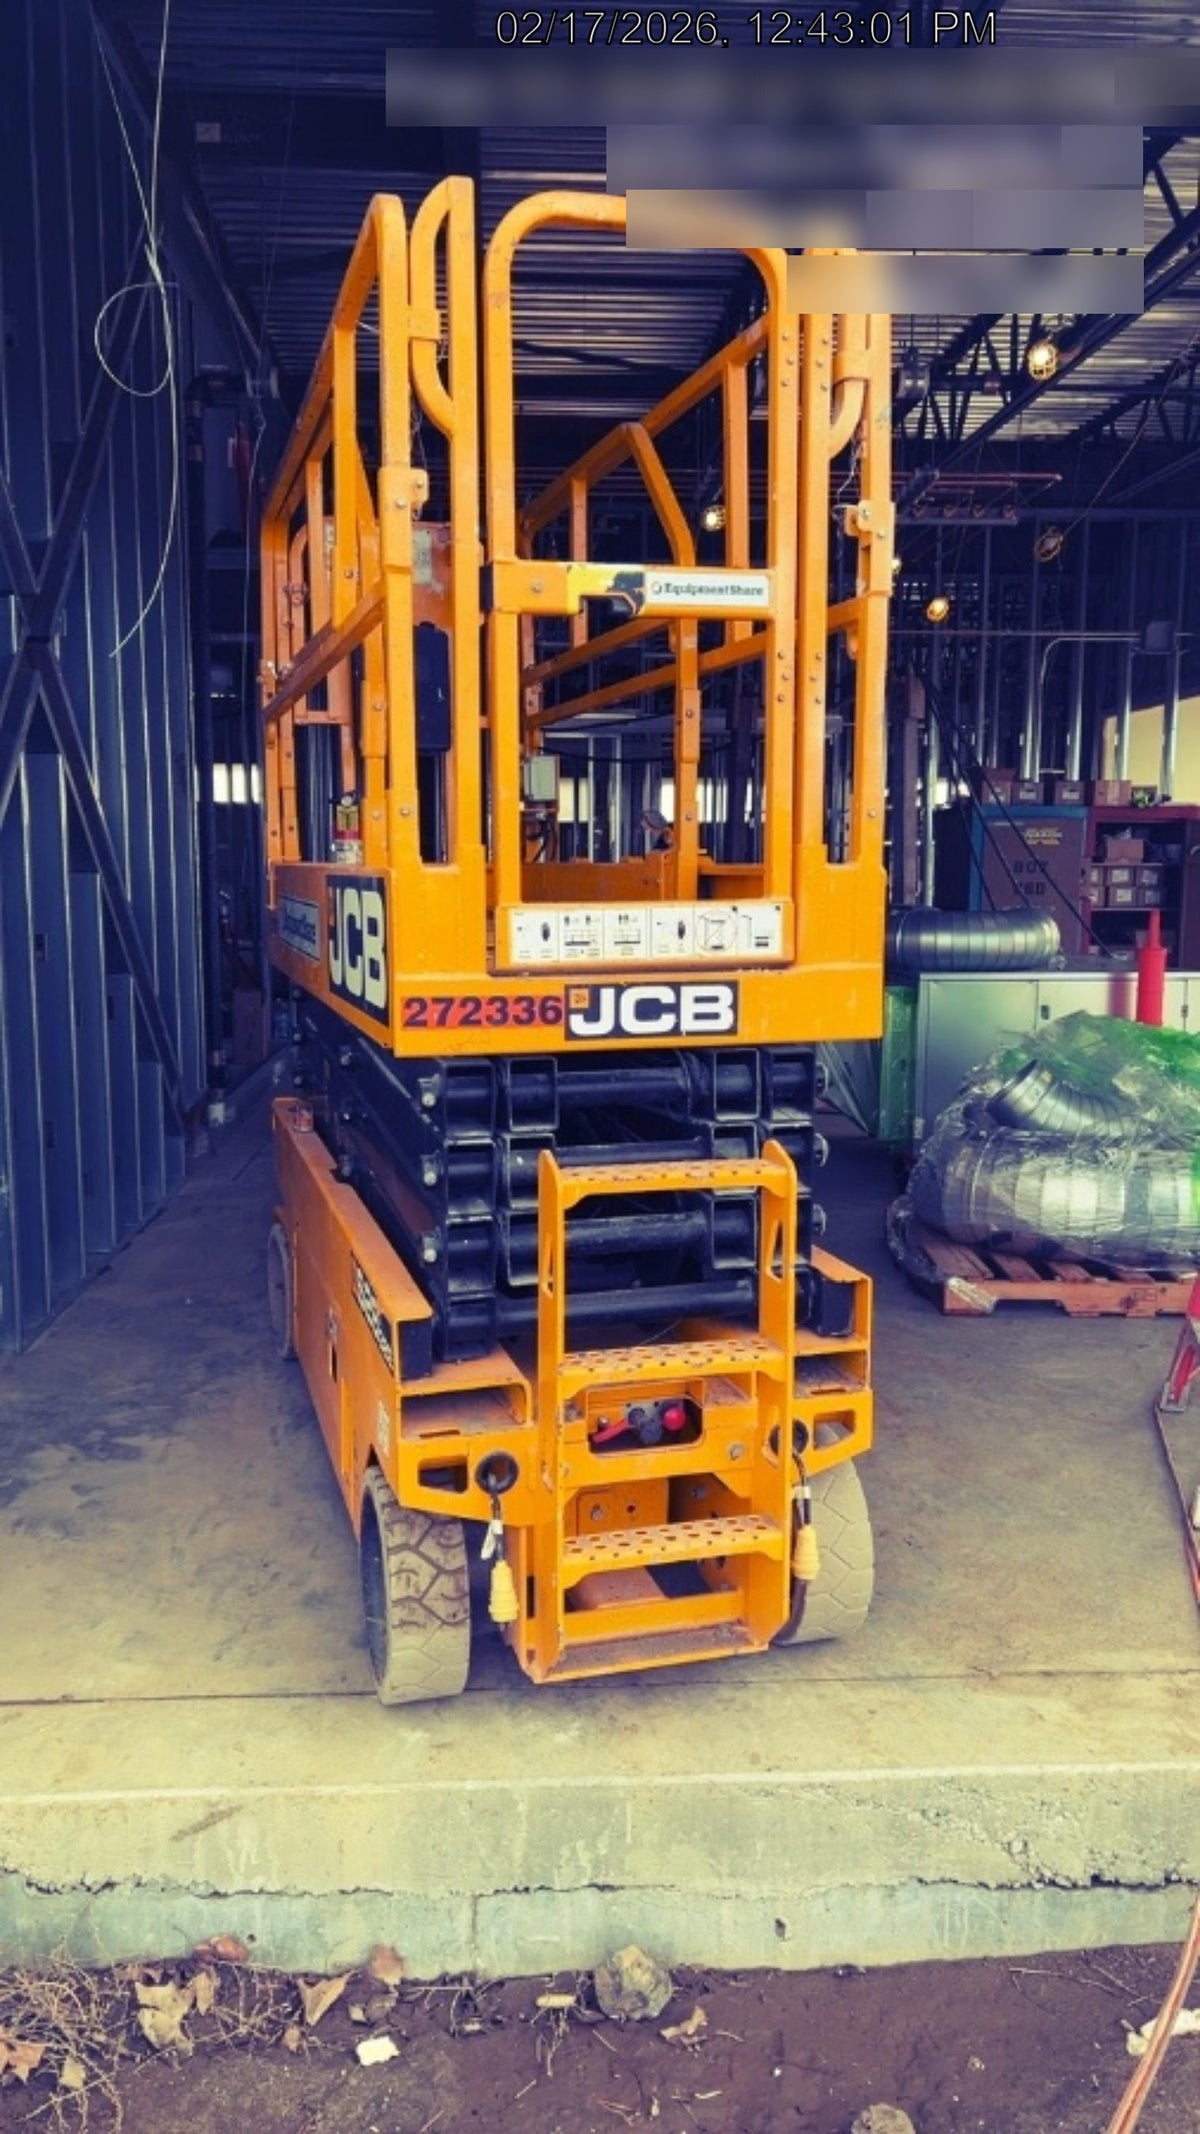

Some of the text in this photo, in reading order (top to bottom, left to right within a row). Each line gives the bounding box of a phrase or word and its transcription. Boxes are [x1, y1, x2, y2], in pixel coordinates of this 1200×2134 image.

[329, 886, 387, 1009] JCB
[402, 996, 563, 1027] 272336
[569, 985, 734, 1036] JCB
